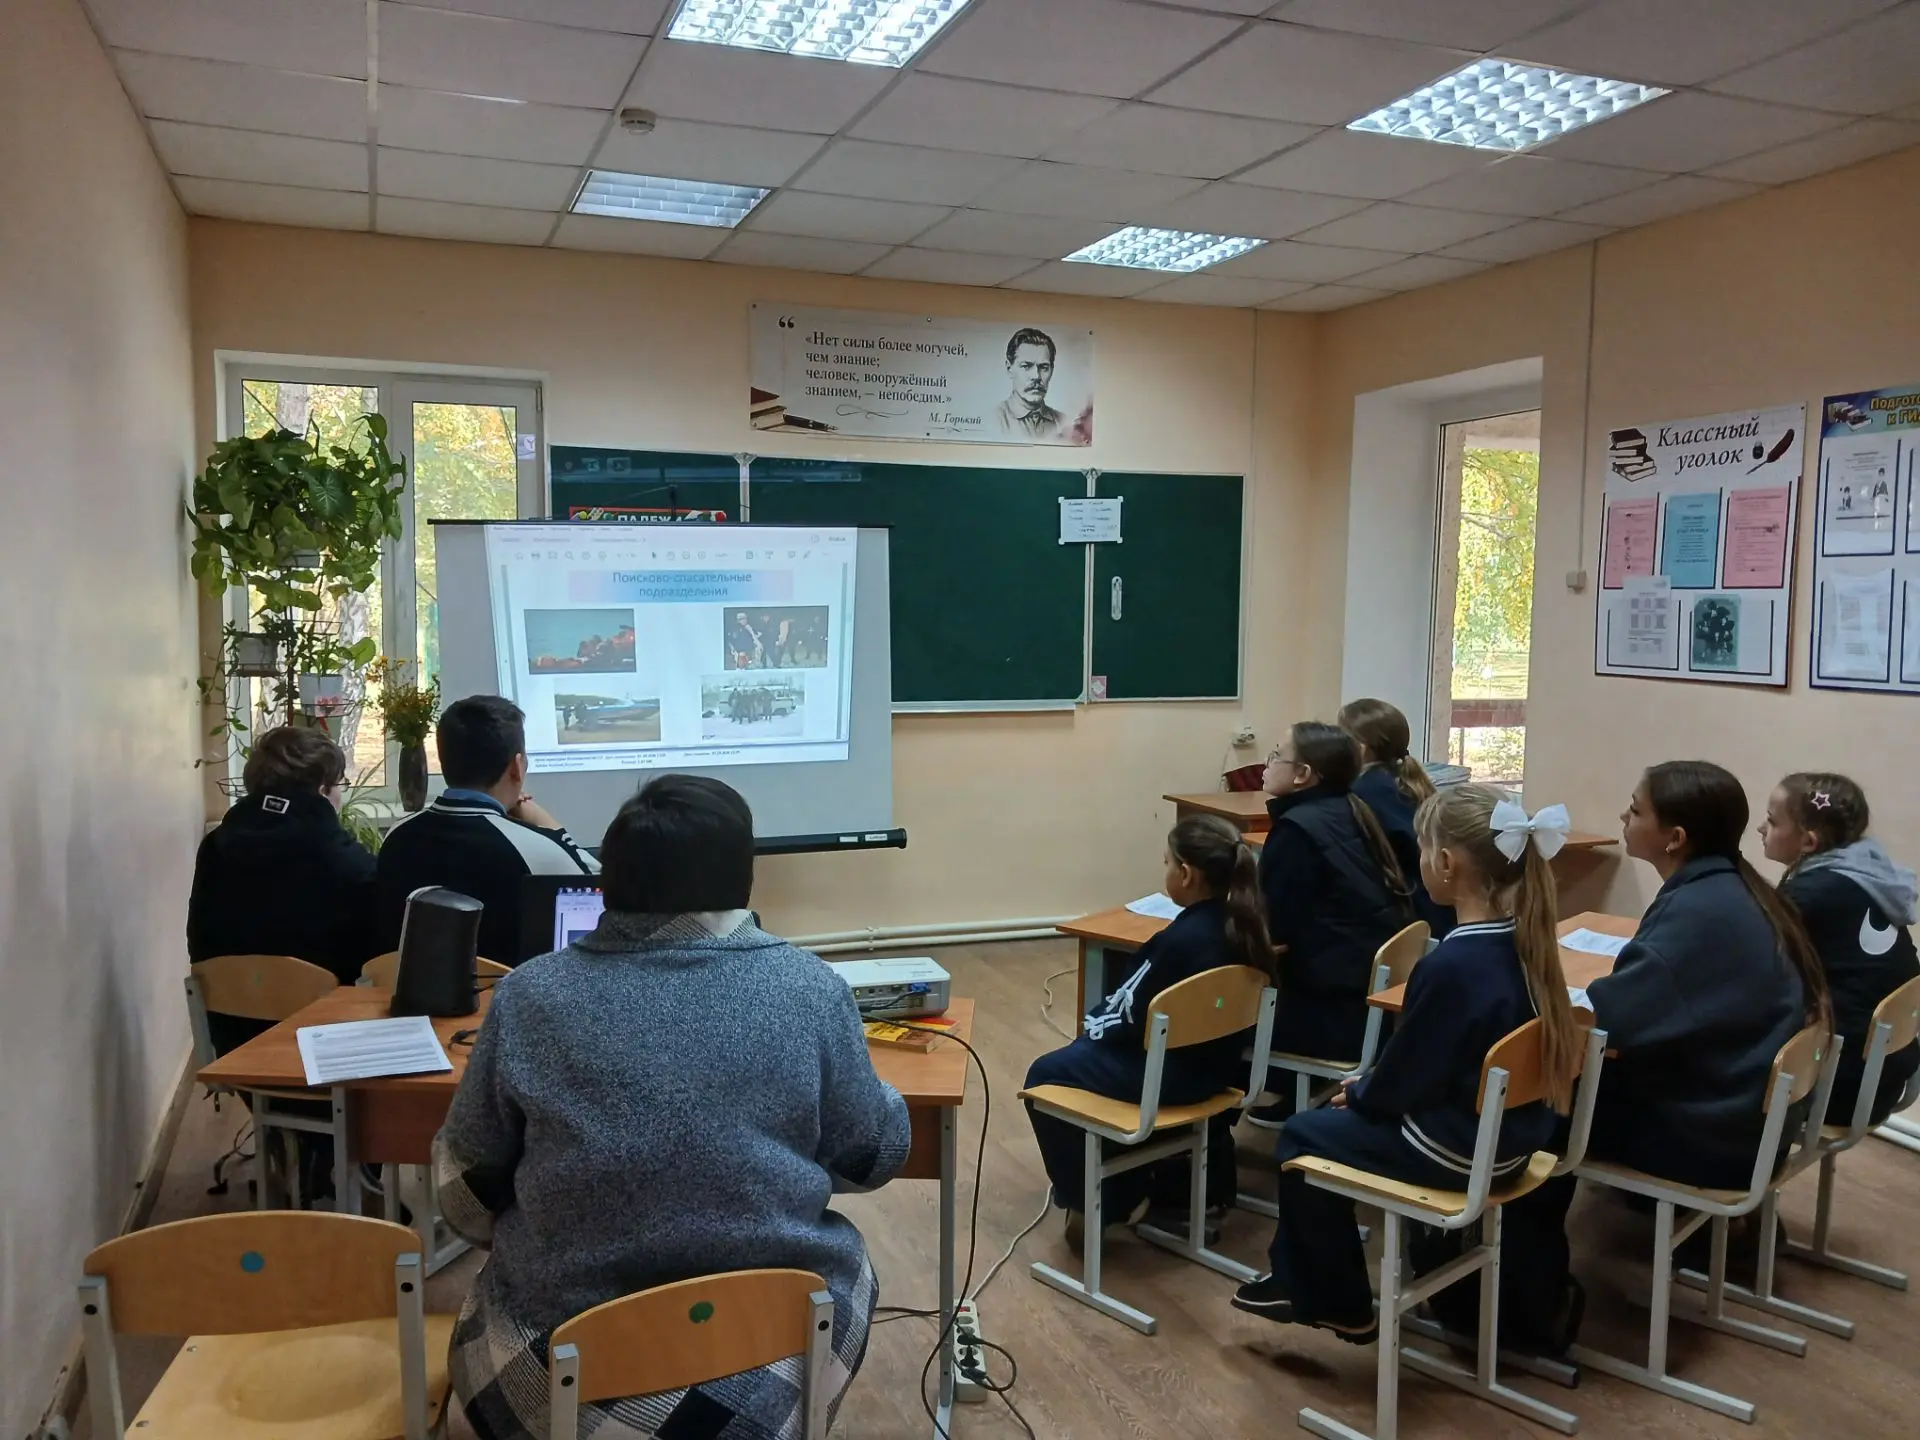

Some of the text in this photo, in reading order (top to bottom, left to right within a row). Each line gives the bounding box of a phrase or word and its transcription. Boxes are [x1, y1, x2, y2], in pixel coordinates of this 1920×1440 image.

[805, 331, 968, 358] «Нет силы более могучей,
[805, 352, 881, 368] чем знание;
[805, 369, 948, 389] человек, вооружённый
[804, 385, 862, 400] знанием,
[878, 388, 952, 404] непобедим.»
[928, 411, 983, 426] М. Горький
[1657, 415, 1760, 448] Классный
[1674, 448, 1744, 476] уголок
[612, 571, 753, 584] Поисково-спасательные
[639, 586, 728, 601] подразделения
